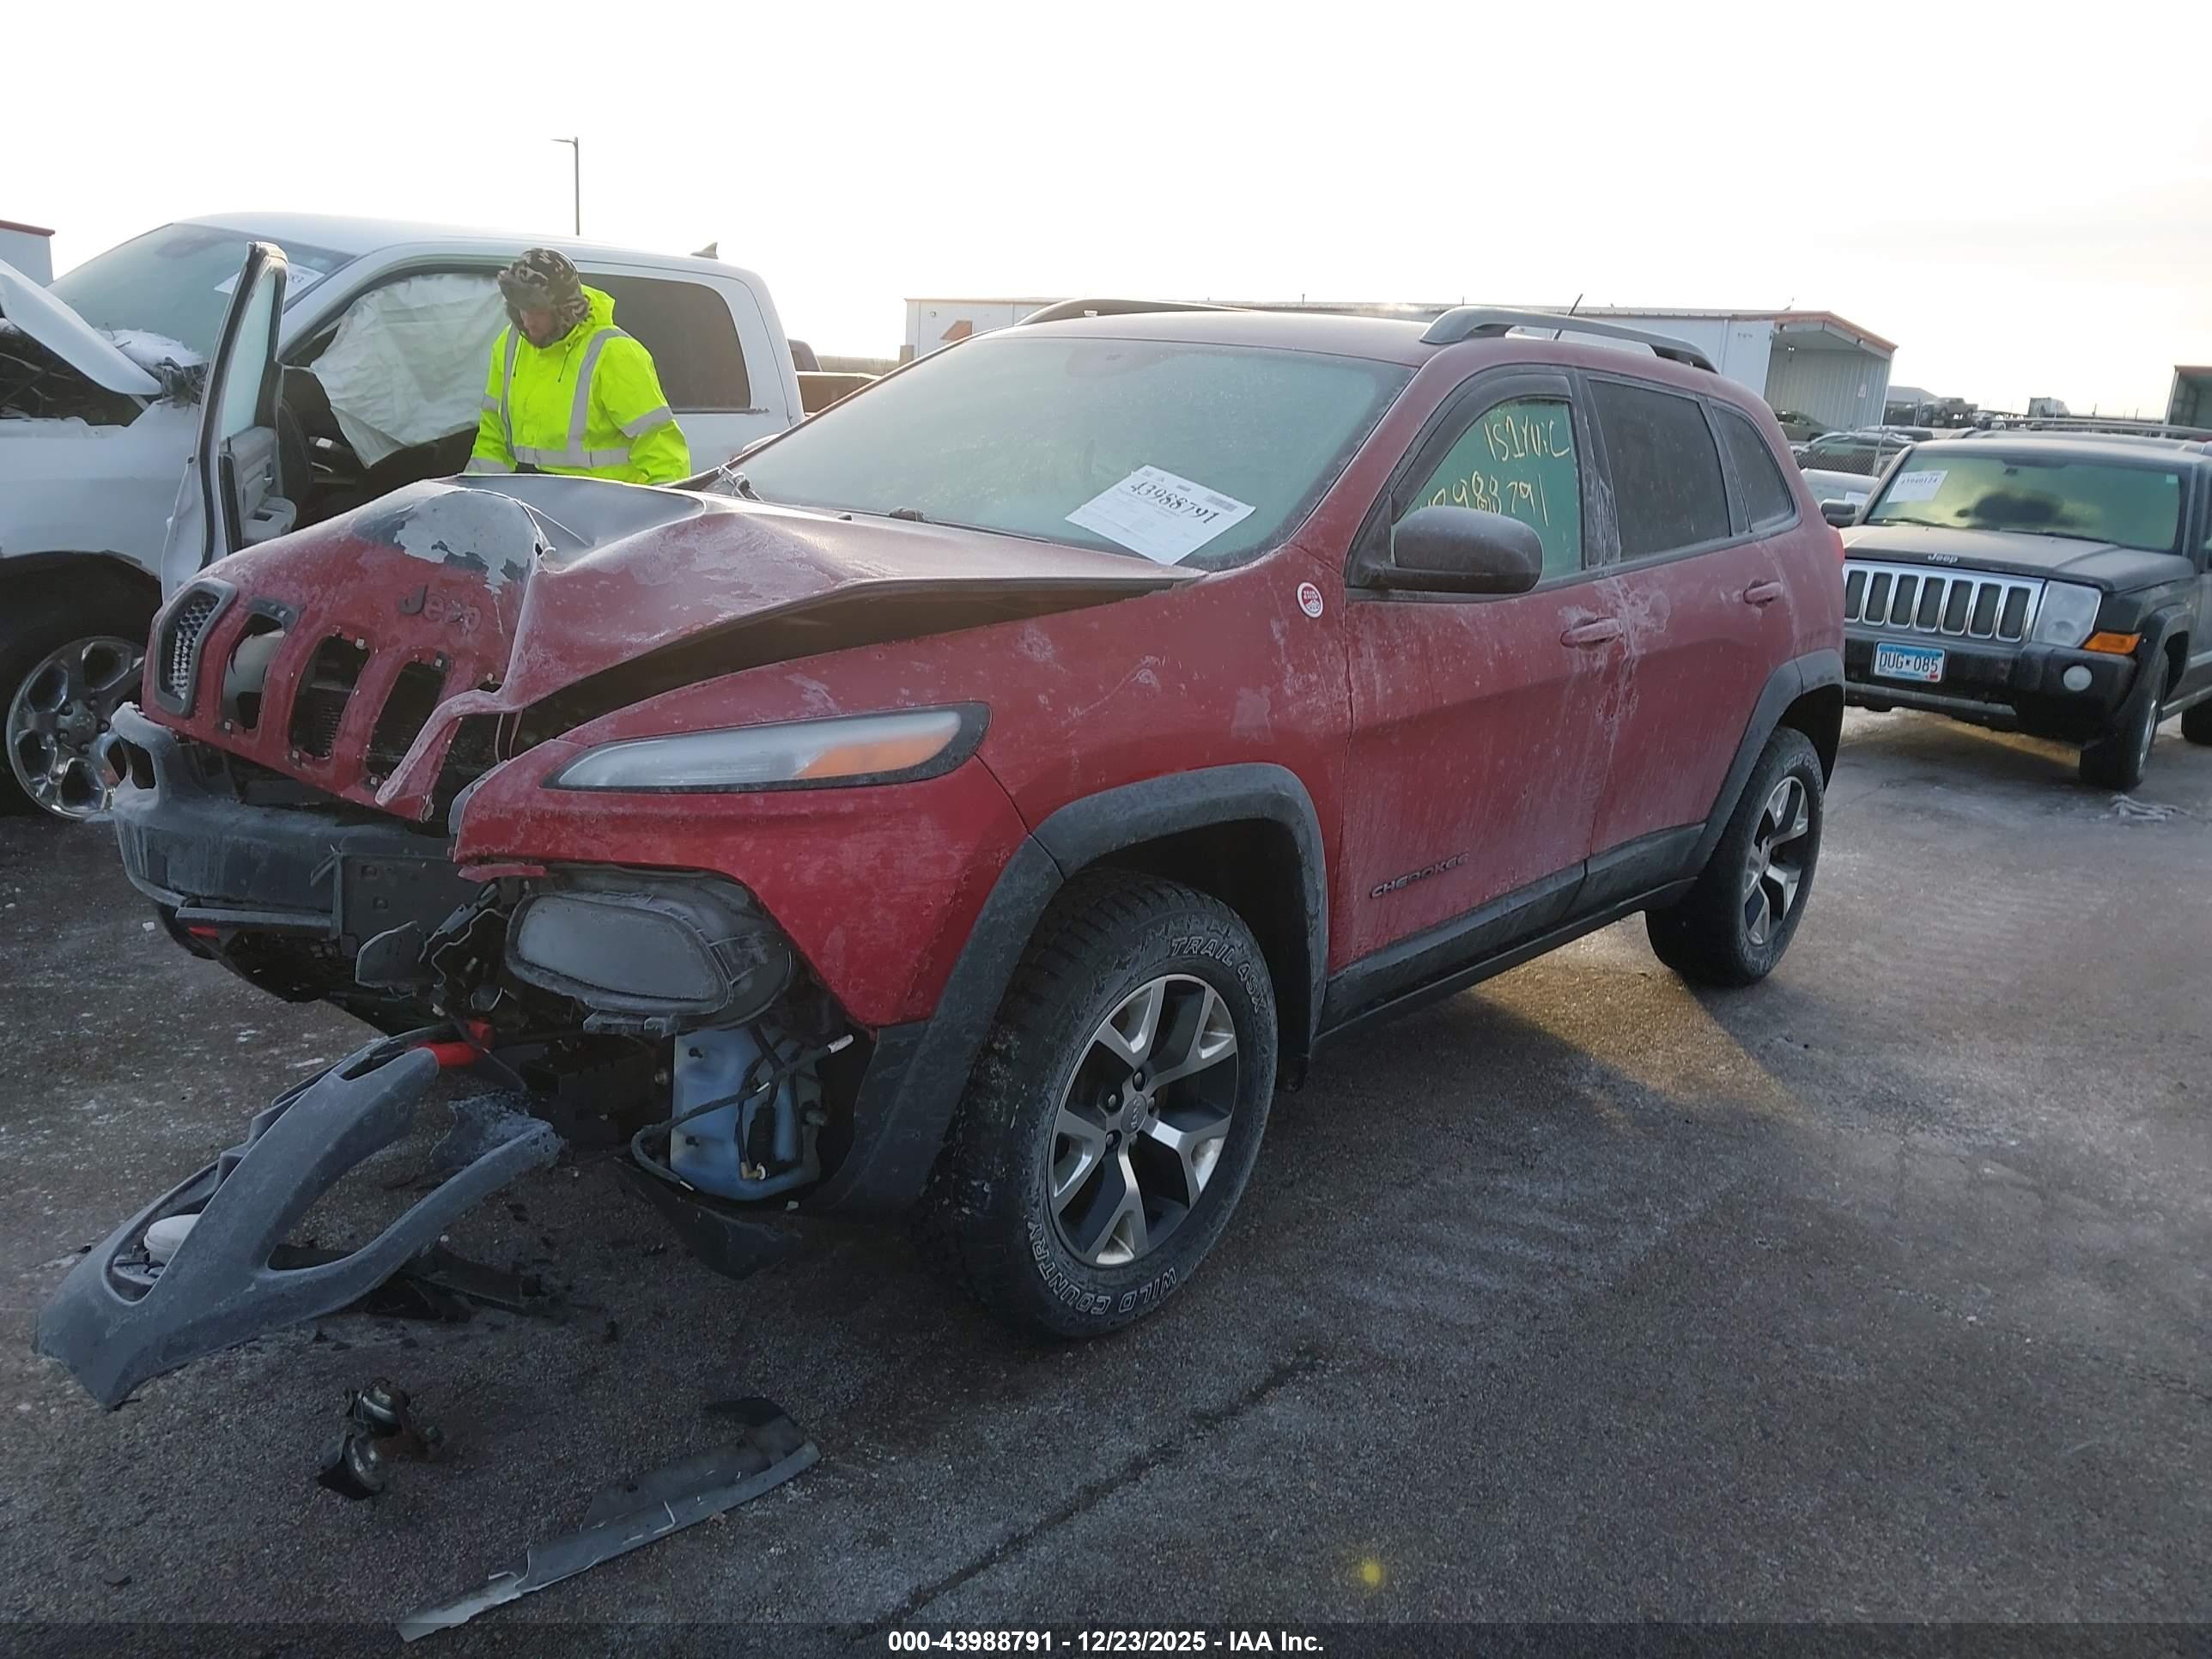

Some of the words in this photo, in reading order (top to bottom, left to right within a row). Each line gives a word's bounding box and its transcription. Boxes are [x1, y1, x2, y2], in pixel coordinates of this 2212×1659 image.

[1130, 481, 1220, 524] 43988791
[1927, 553, 1959, 564] Jeep
[1880, 652, 1905, 670] DUG
[1913, 655, 1939, 674] 085
[1170, 935, 1236, 968] TRAIL
[1237, 962, 1267, 1014] 4SX
[1027, 1221, 1111, 1316] COUNTRY
[1118, 1267, 1177, 1313] WILD
